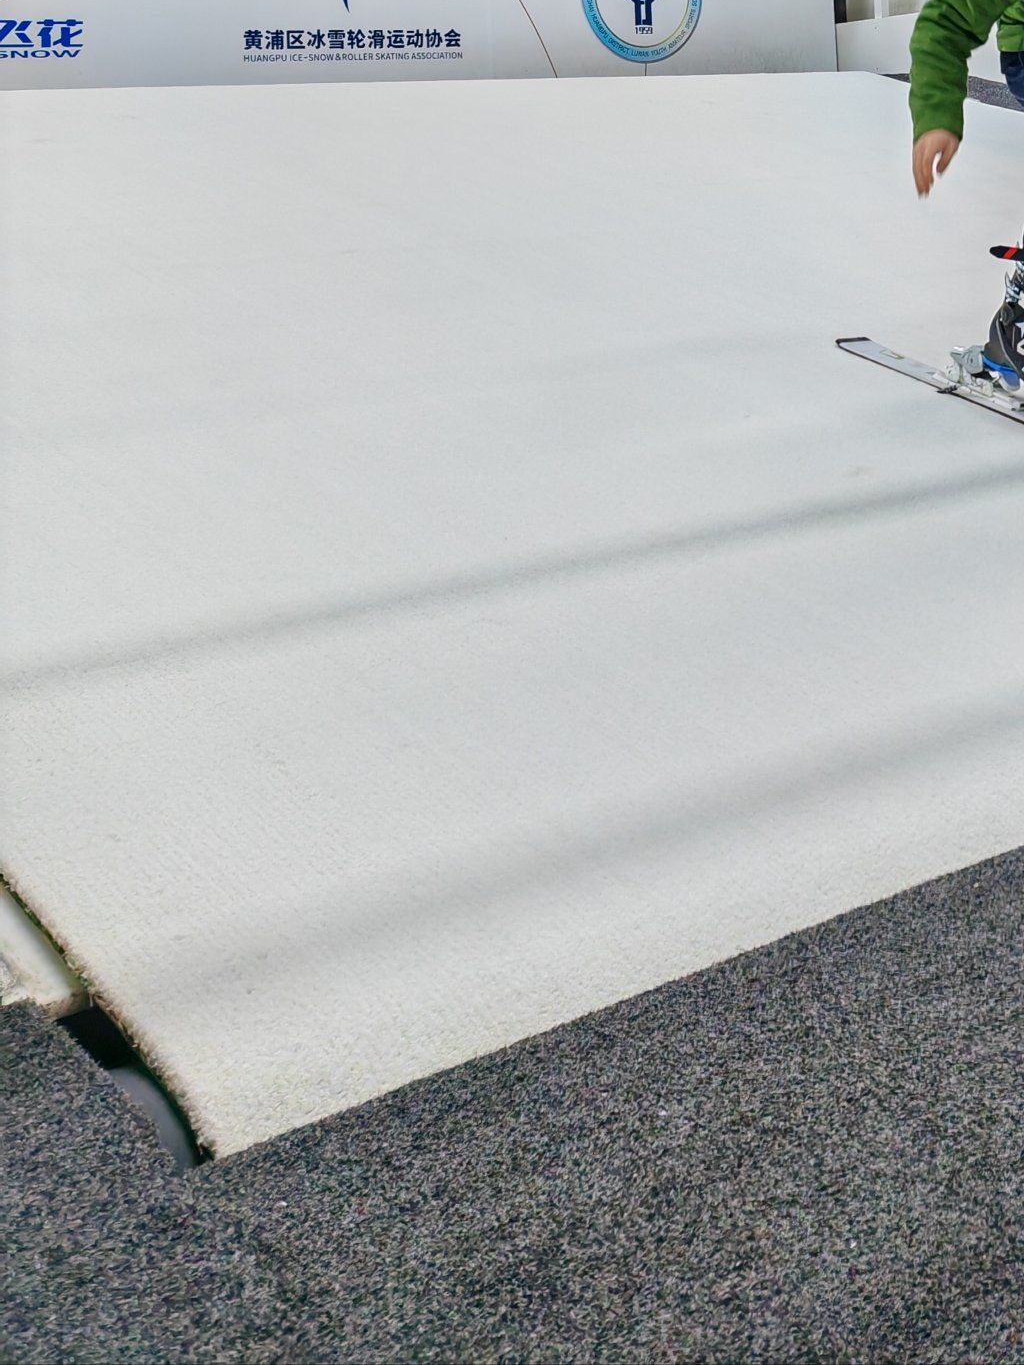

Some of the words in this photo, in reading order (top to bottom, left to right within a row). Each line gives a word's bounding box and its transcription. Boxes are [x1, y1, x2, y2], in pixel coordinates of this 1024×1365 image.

[243, 28, 461, 50] 黄浦区冰雪轮滑运动协会
[243, 54, 287, 62] HUANGPU
[375, 52, 410, 61] SKATING
[411, 51, 463, 60] ASSOCIATION
